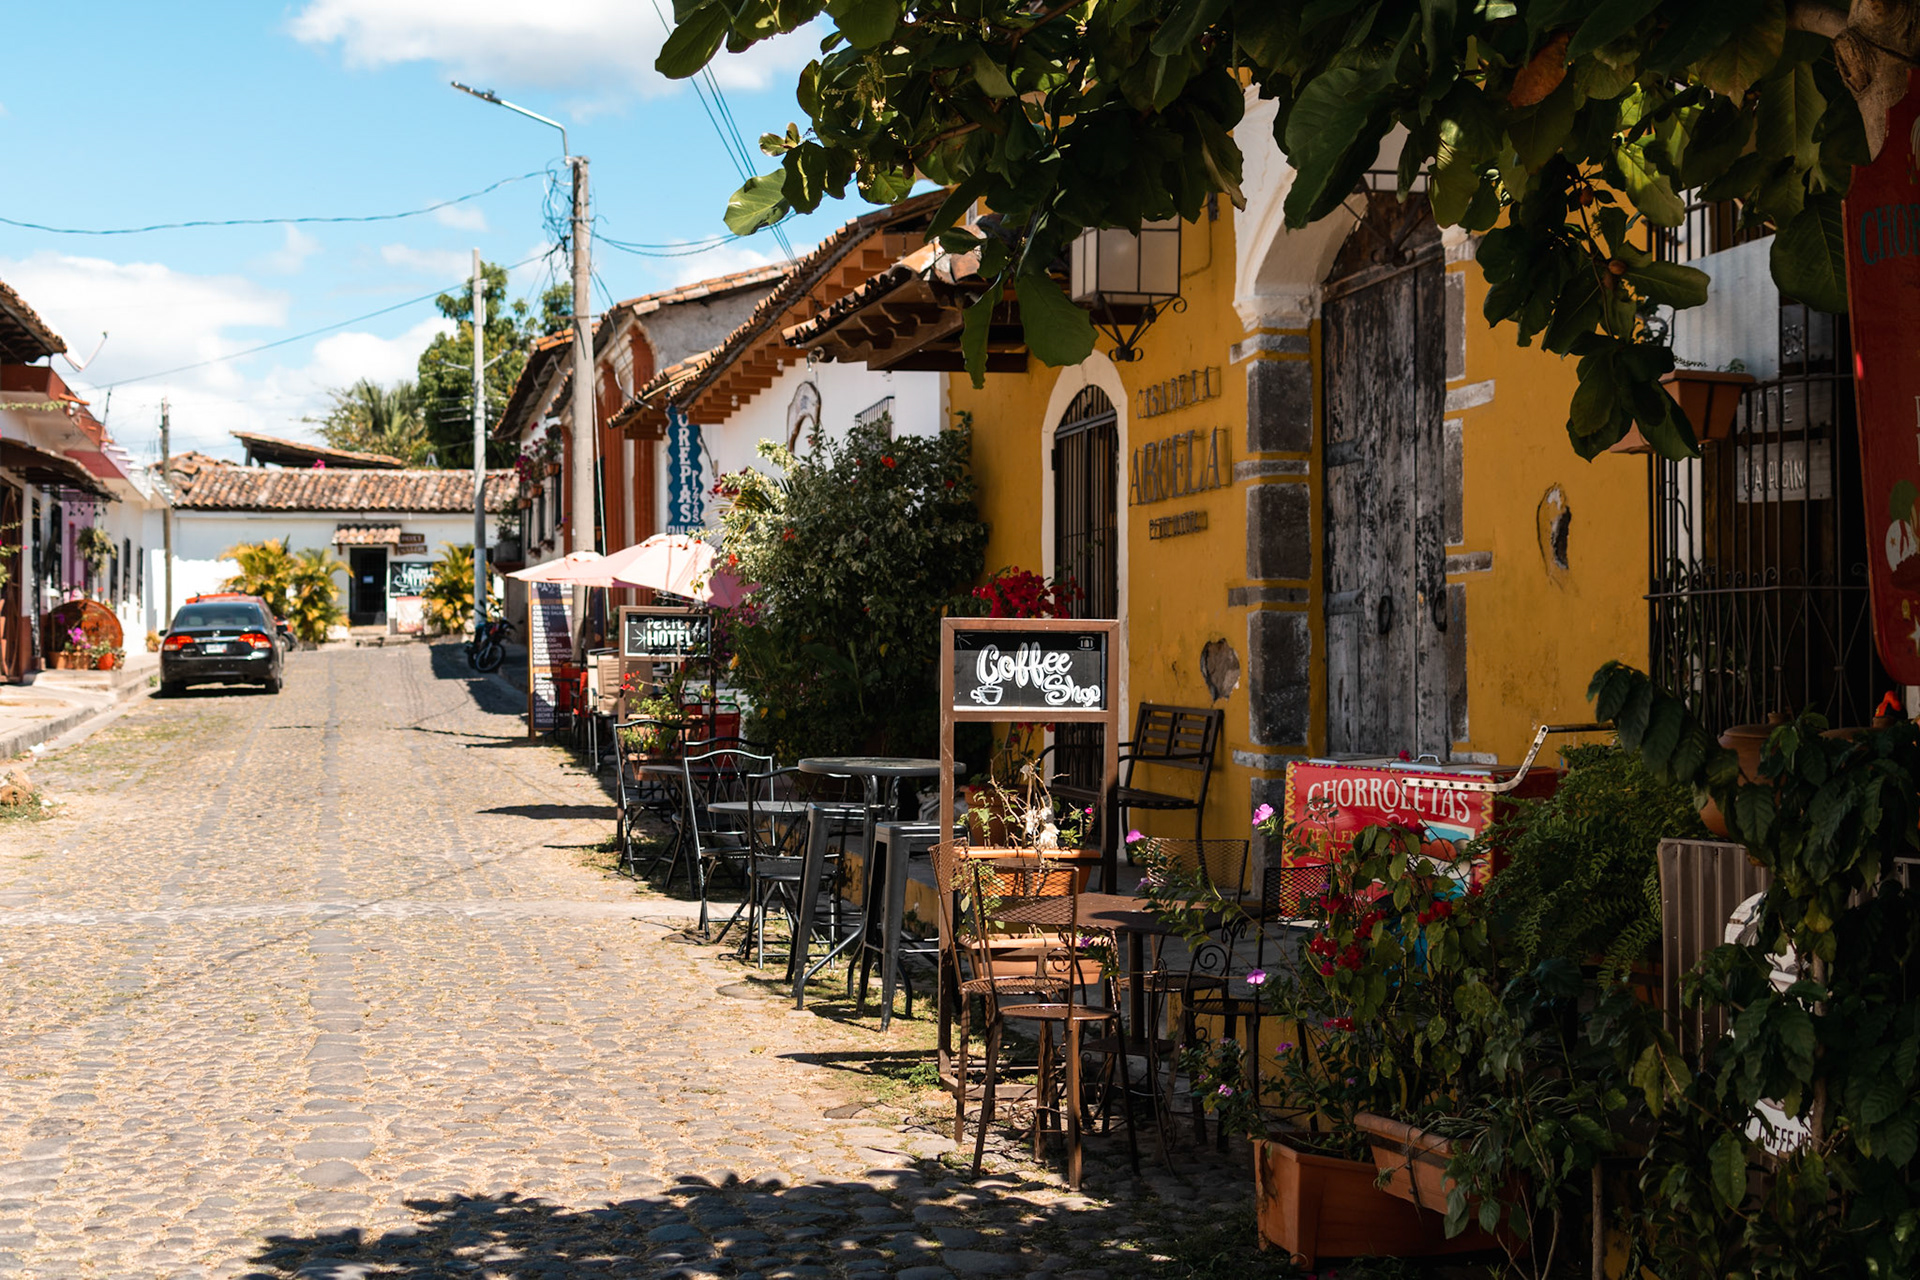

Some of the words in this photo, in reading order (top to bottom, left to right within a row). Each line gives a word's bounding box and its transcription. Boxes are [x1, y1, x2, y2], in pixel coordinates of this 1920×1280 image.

[1136, 382, 1168, 419] CASA
[1170, 374, 1187, 409] DE
[1191, 366, 1212, 402] LA
[1128, 426, 1221, 507] ABUELA
[691, 470, 700, 523] PIZZAS
[643, 617, 685, 630] Petit
[647, 630, 694, 646] HOTEL
[977, 643, 1073, 689] Coffee
[1041, 674, 1101, 708] Shop
[1307, 778, 1471, 823] CHORROLETAS
